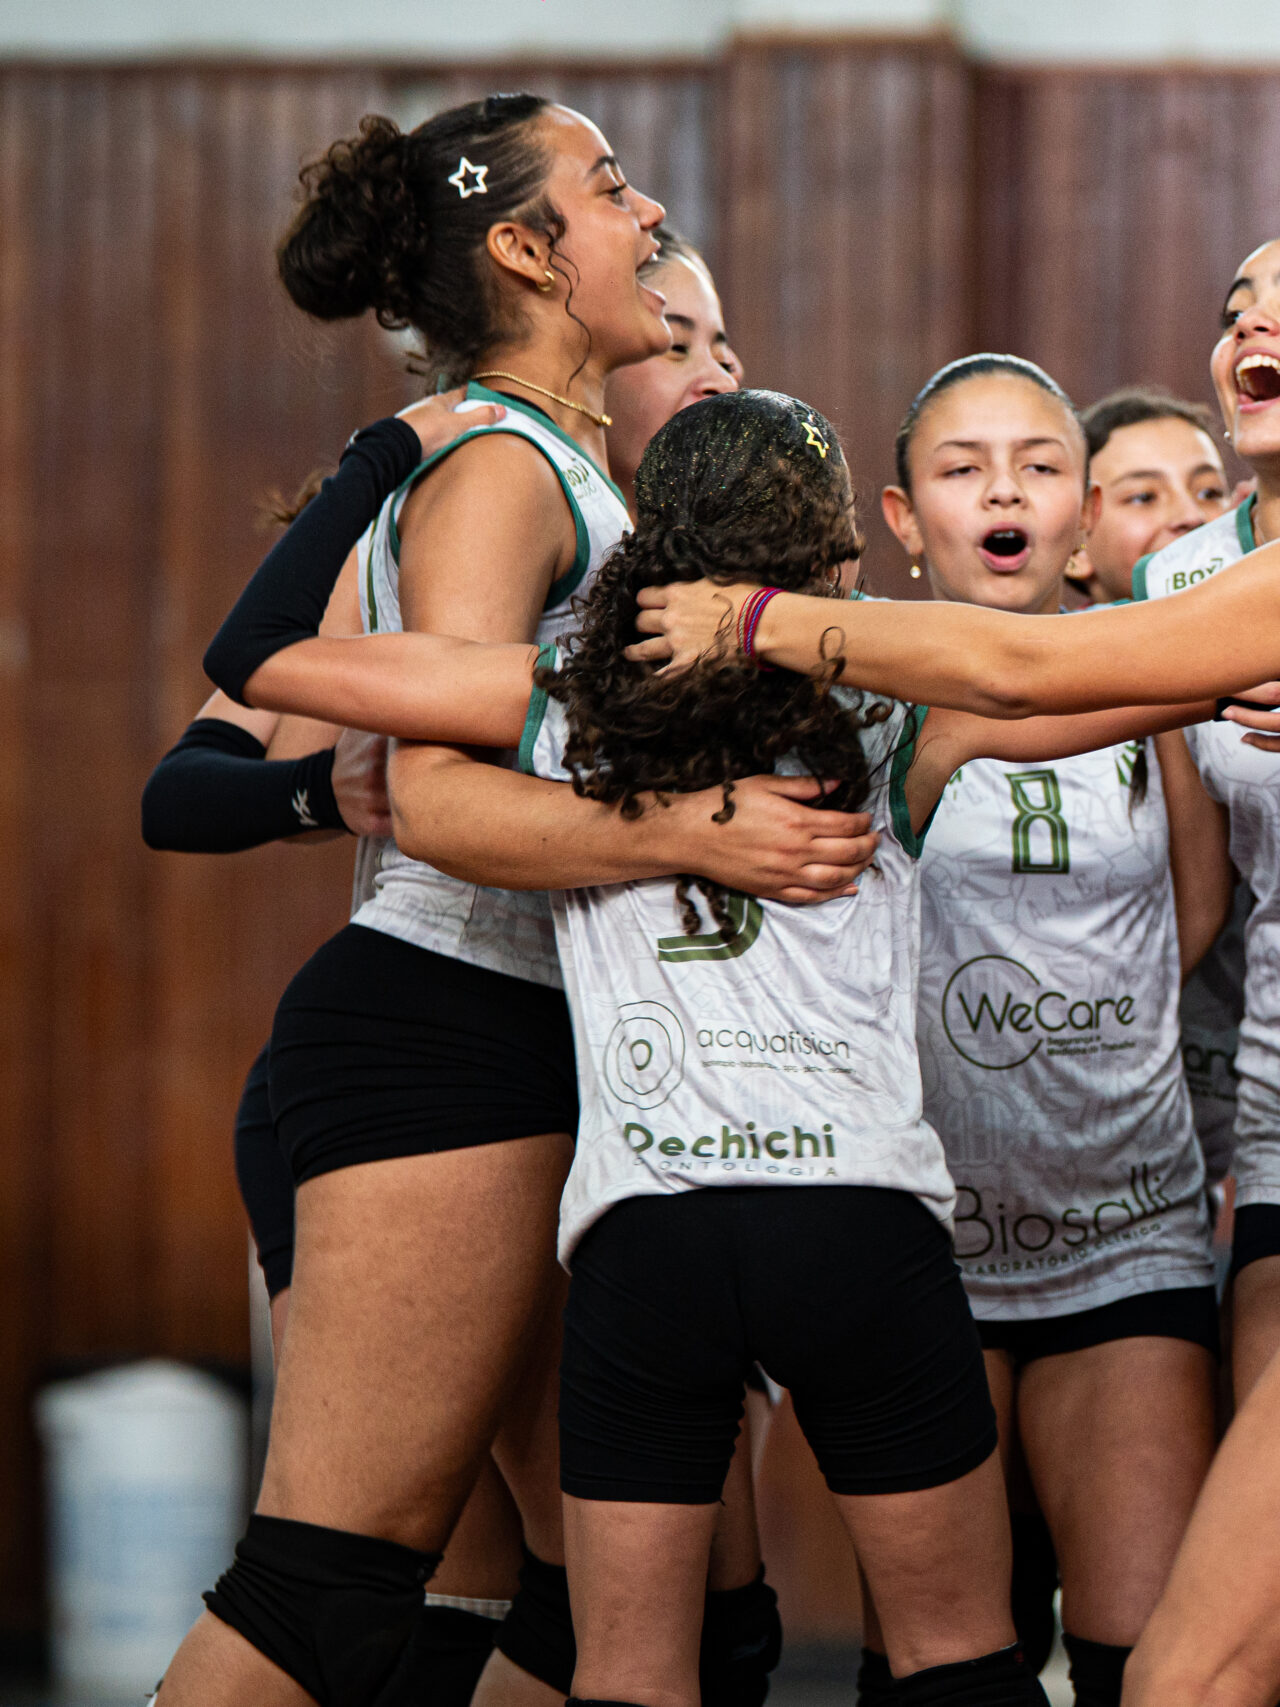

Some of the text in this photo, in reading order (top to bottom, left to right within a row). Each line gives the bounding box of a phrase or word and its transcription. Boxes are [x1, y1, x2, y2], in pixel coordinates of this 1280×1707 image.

[1004, 768, 1070, 875] 8
[957, 990, 1137, 1034] WeCare
[623, 1121, 836, 1160] Dechichi
